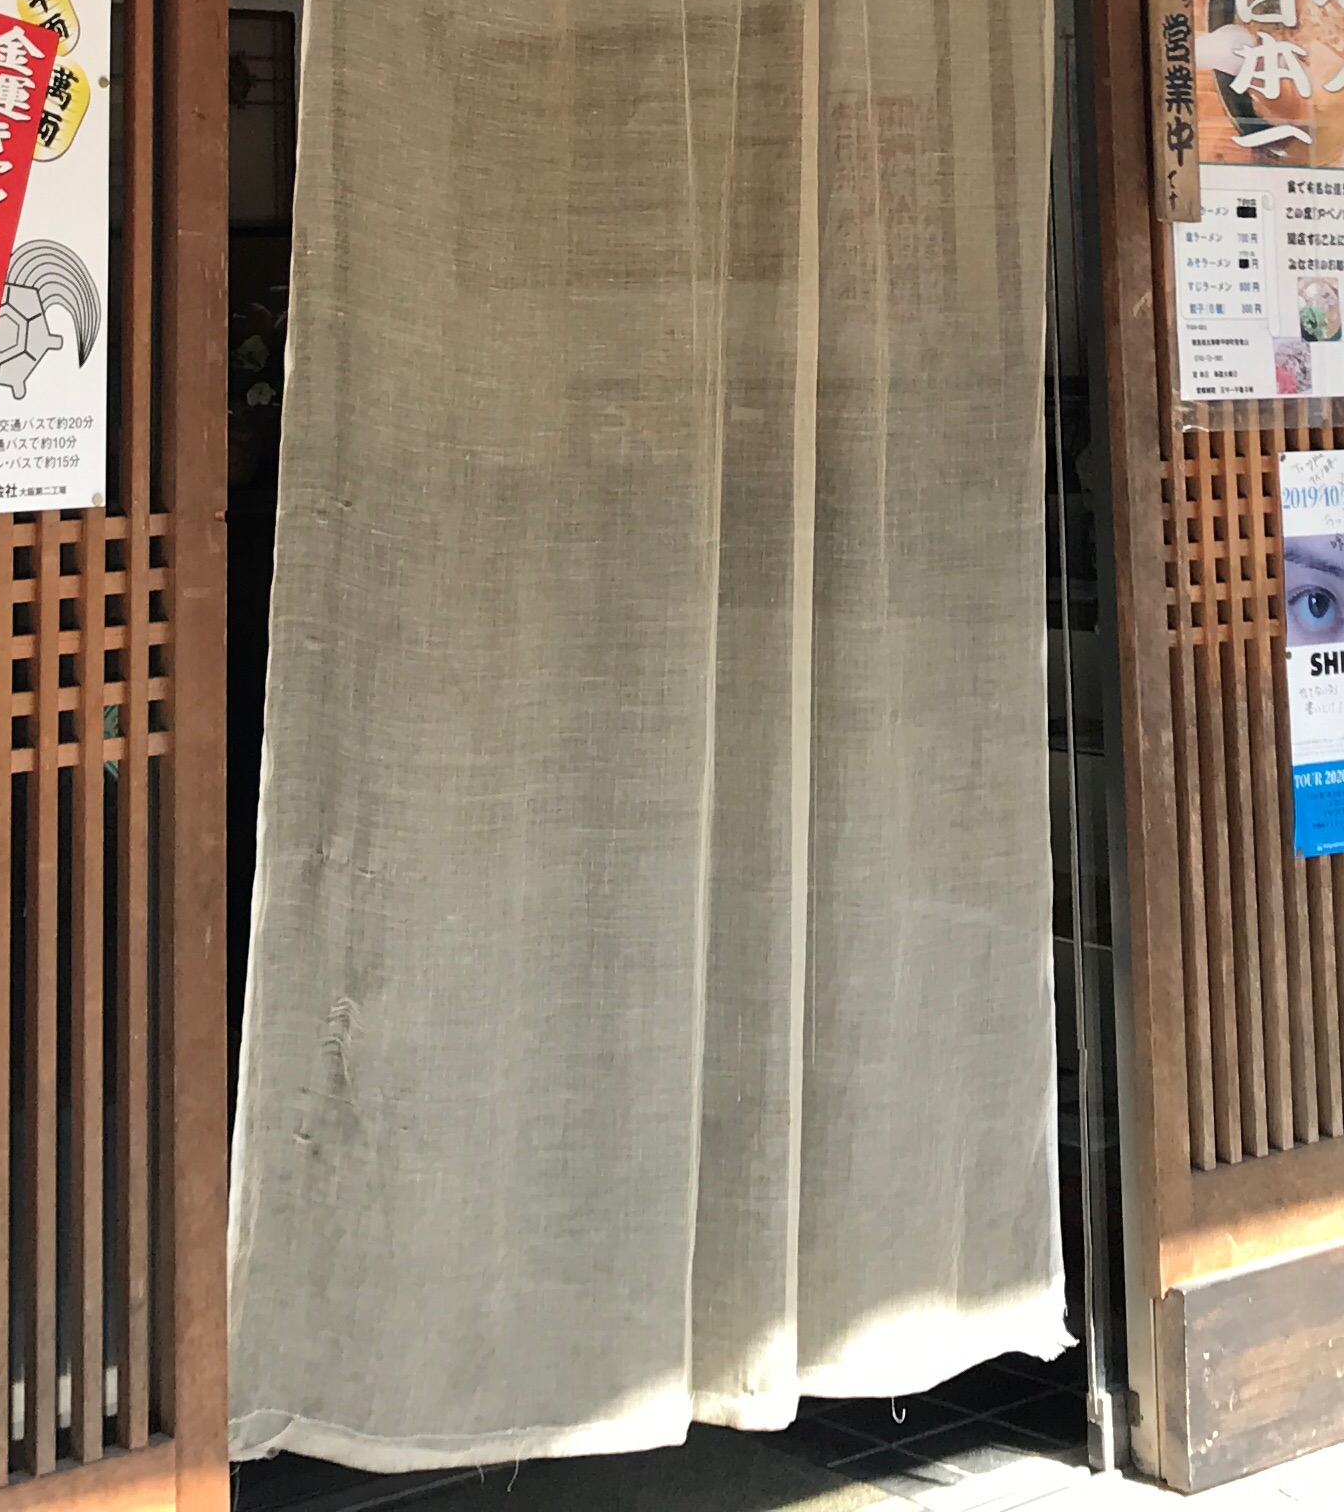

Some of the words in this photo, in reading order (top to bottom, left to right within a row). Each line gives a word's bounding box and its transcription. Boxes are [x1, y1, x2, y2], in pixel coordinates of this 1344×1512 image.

[1162, 13, 1195, 167] 営業中
[1294, 770, 1323, 789] TOUR
